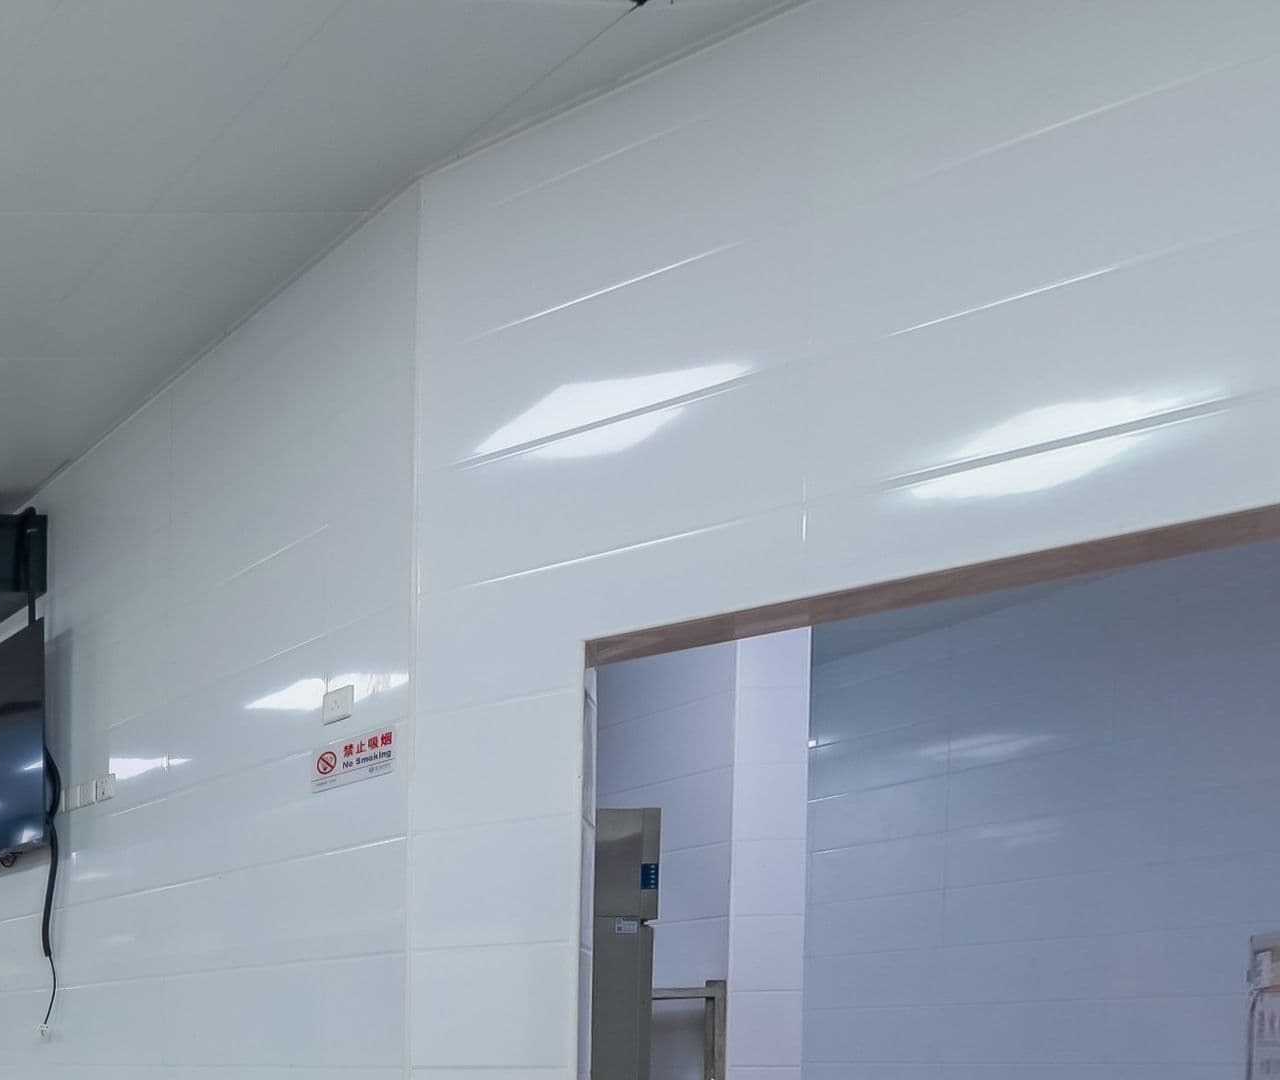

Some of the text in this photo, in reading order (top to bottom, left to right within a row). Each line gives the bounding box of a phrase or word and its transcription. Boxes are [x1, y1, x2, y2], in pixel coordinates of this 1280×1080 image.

[343, 731, 393, 758] 禁止吸烟
[342, 750, 392, 769] No Smoking
